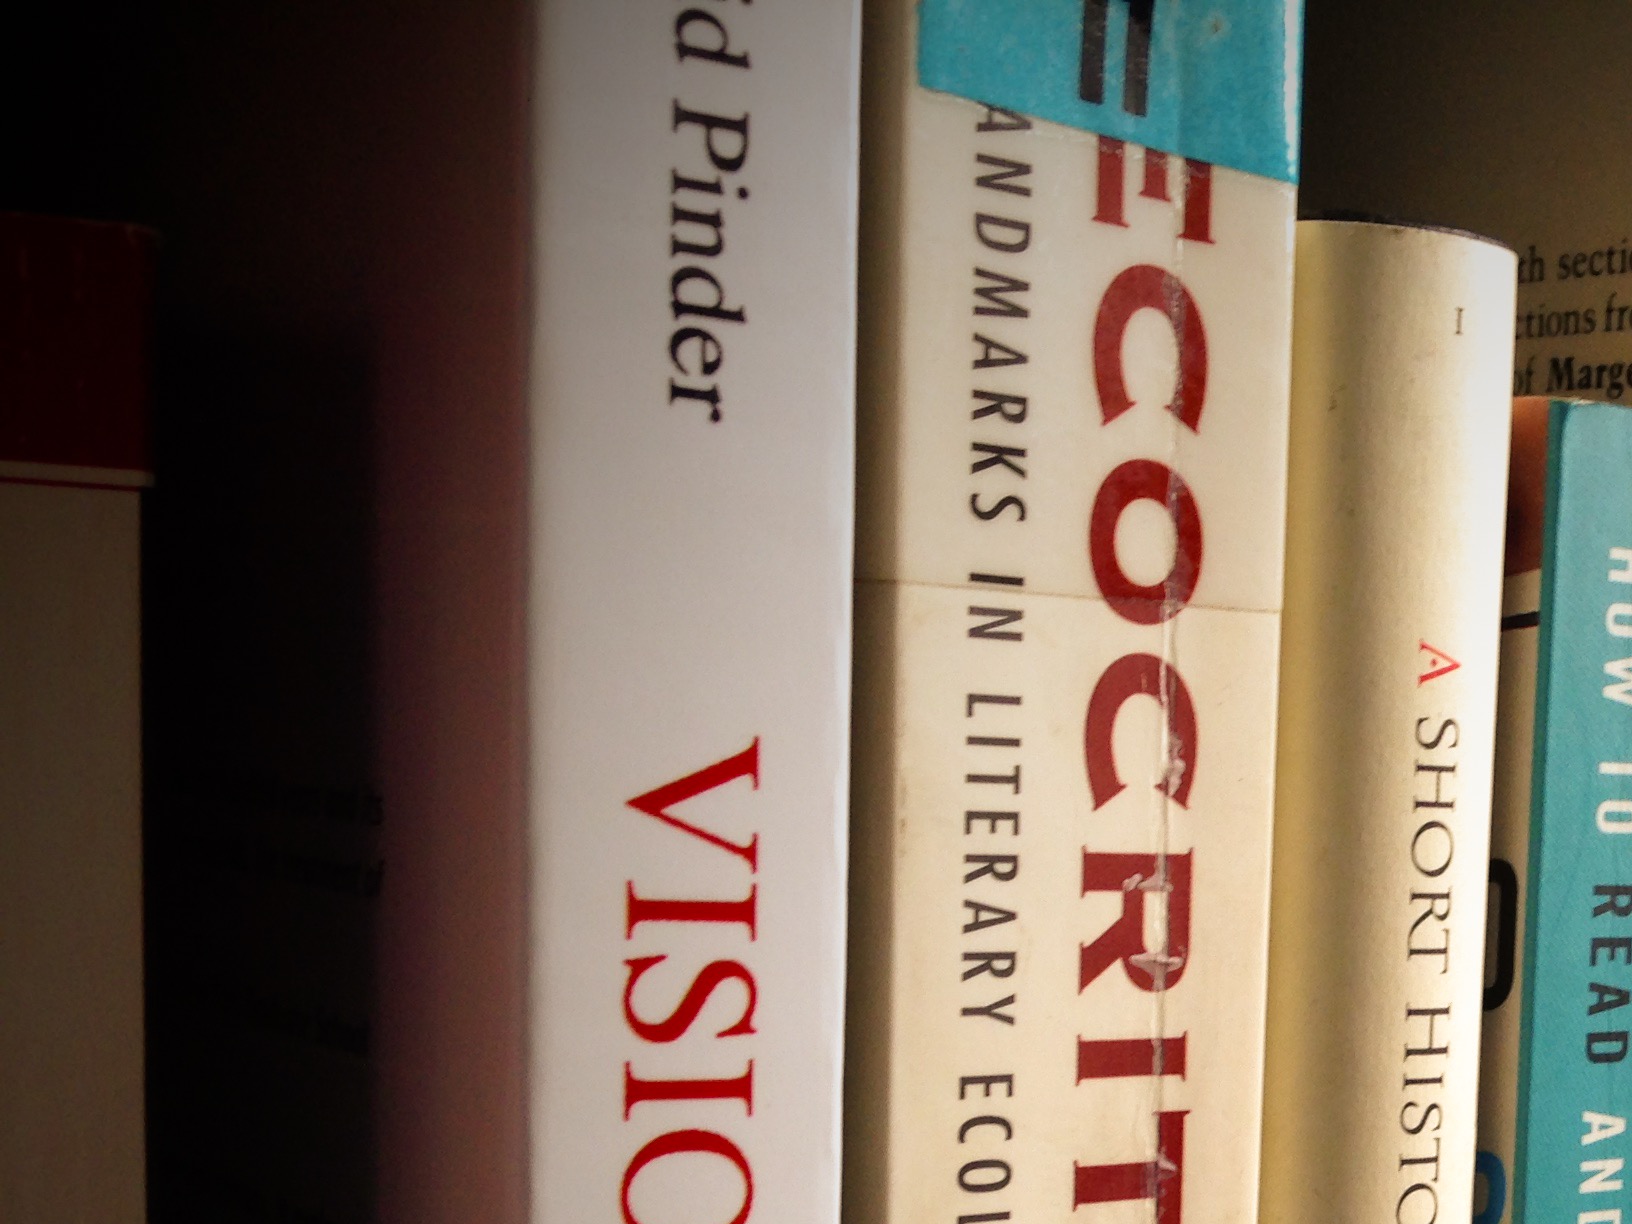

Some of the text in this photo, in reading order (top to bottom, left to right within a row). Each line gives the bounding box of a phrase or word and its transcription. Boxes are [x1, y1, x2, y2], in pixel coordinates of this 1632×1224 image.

[668, 98, 750, 424] Pinder
[967, 573, 1024, 643] IN
[1418, 639, 1461, 688] A
[960, 695, 1023, 1026] LITERARY
[1407, 716, 1460, 974] SHORT
